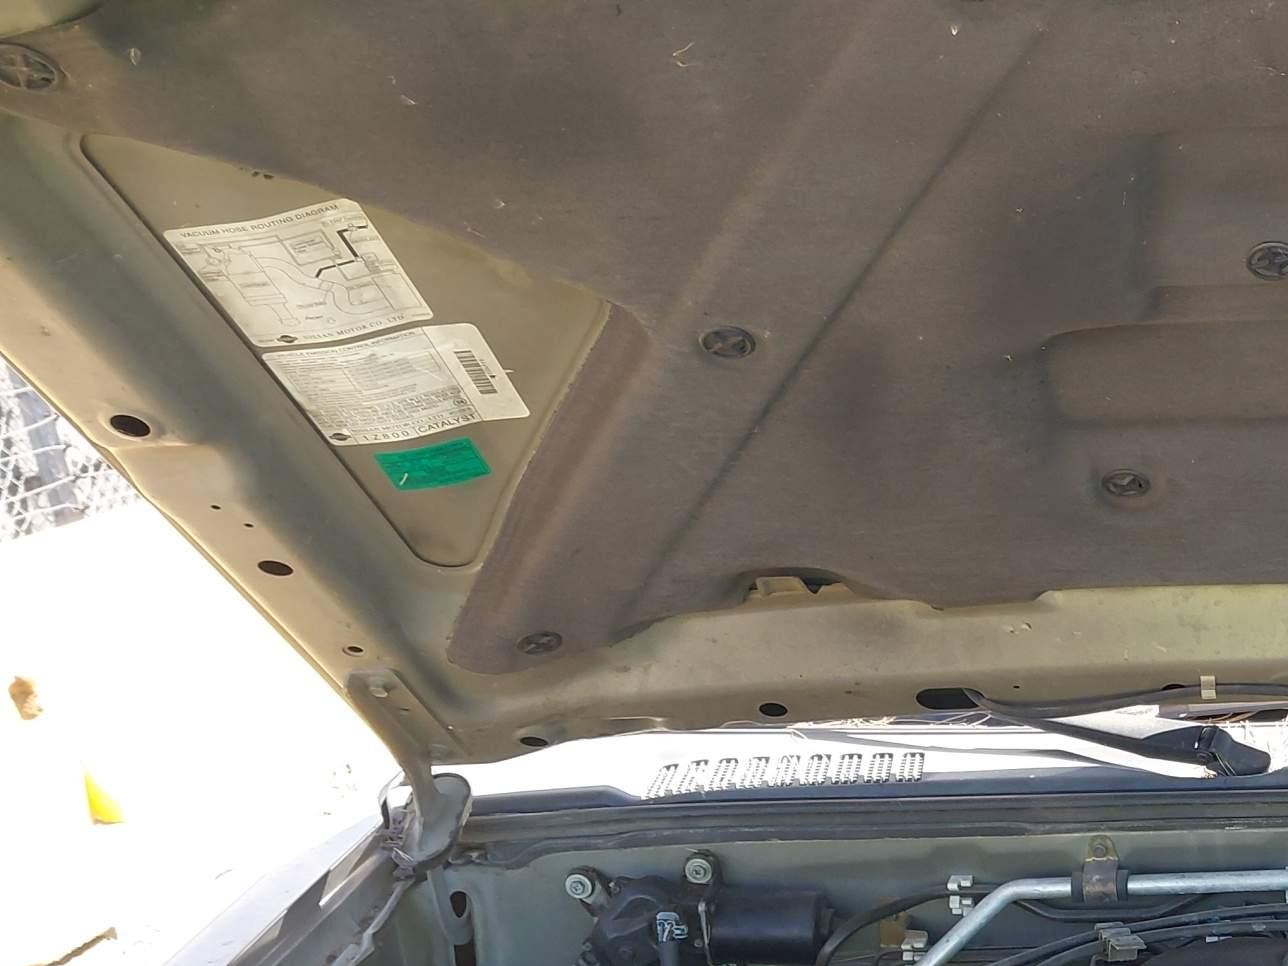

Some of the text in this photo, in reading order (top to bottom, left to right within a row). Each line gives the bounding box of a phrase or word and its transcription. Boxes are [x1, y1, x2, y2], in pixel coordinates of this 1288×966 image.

[180, 228, 220, 238] VACUUM
[221, 226, 248, 234] HOSE
[250, 216, 293, 231] ROUTING
[295, 204, 339, 220] DIAGRAM
[417, 413, 476, 433] CATALYST
